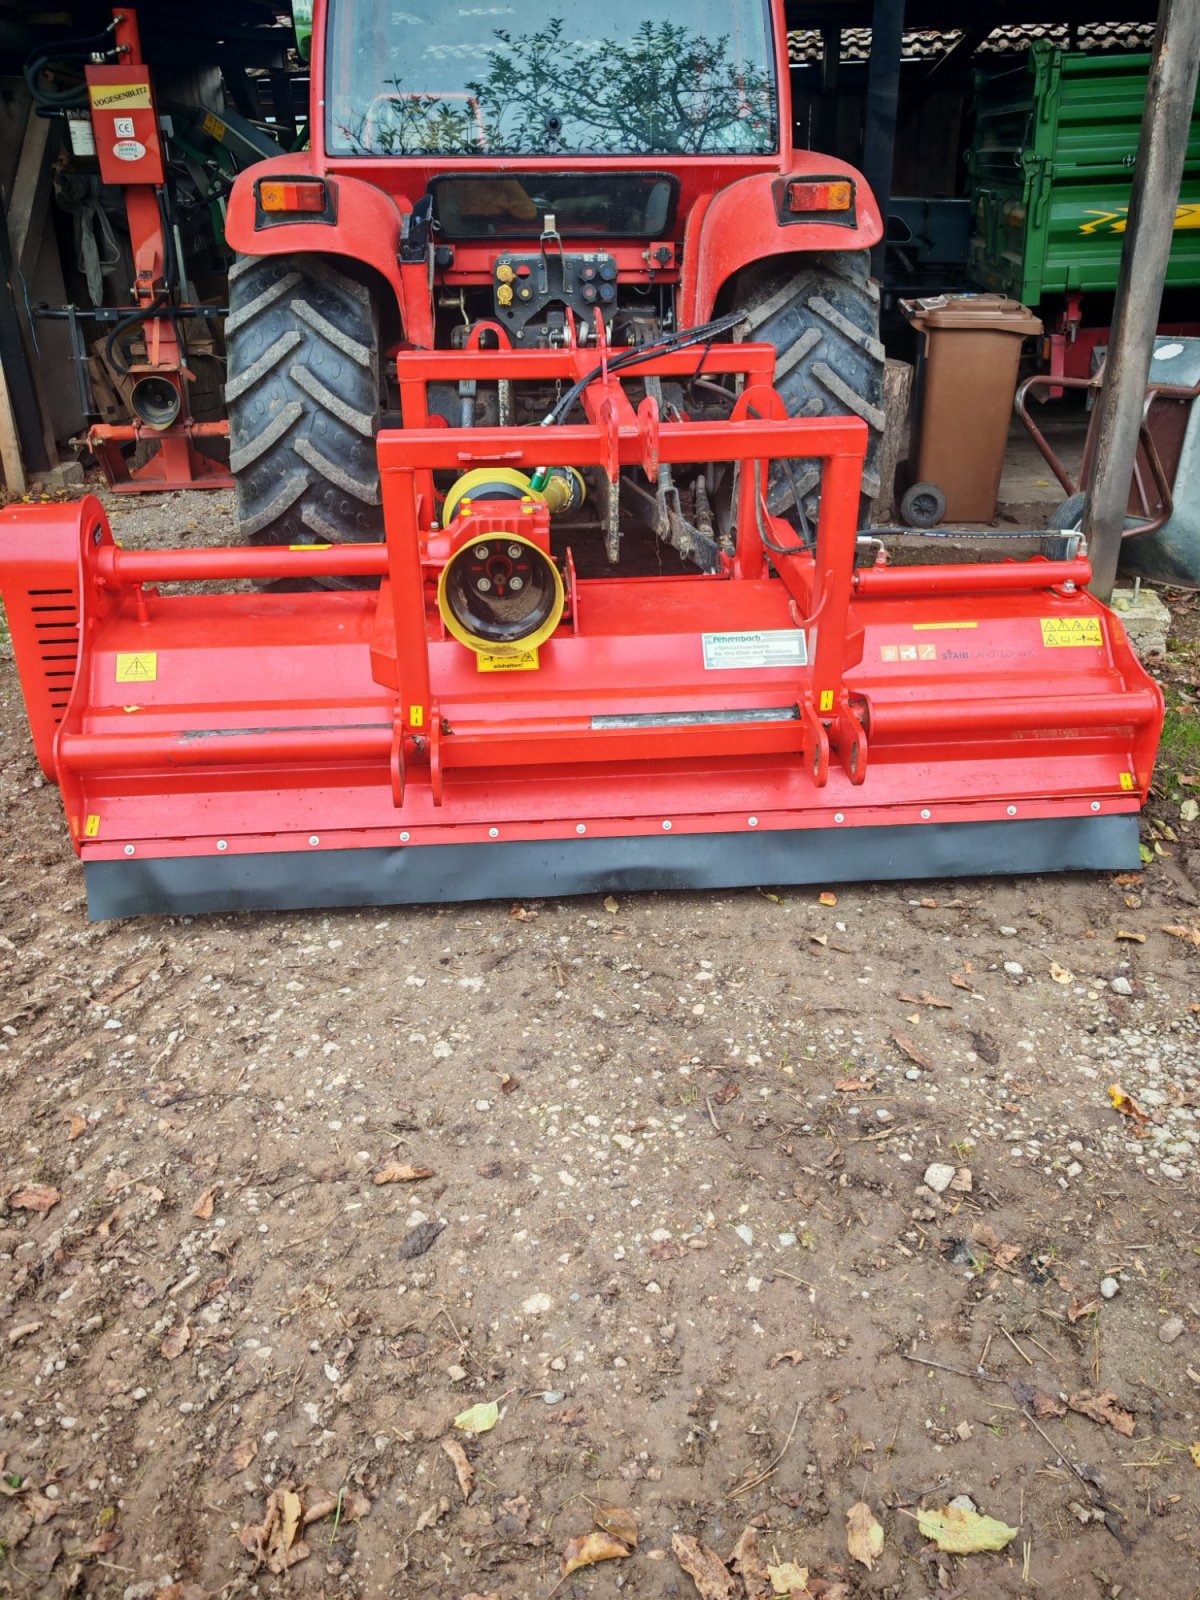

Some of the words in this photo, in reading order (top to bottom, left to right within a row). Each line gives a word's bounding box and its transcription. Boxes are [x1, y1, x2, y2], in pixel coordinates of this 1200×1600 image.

[93, 86, 147, 107] VOGESENBLITZ
[118, 123, 131, 133] CE
[712, 635, 761, 643] Fehrenbach
